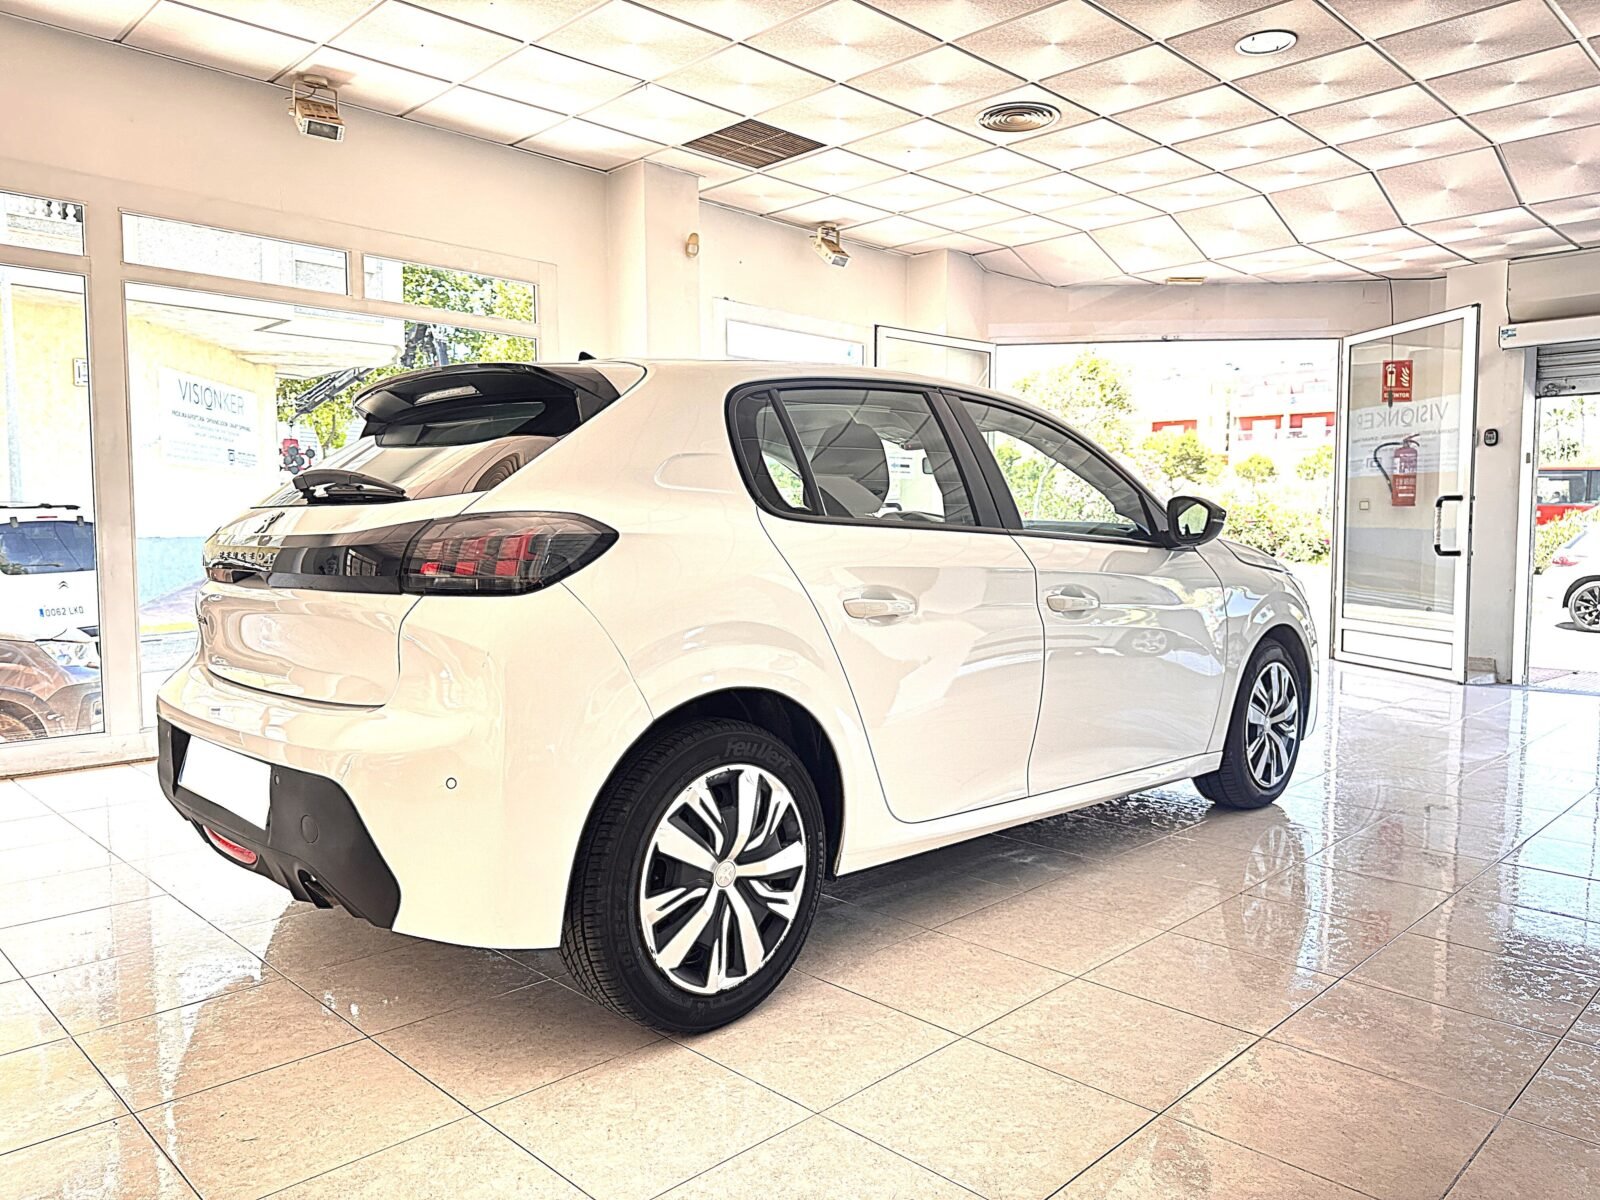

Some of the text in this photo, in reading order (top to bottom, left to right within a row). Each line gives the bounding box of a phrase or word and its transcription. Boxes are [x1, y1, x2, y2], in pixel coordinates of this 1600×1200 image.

[178, 378, 245, 415] VISIONKER
[1383, 391, 1410, 399] EINTOR
[45, 607, 67, 617] 0062
